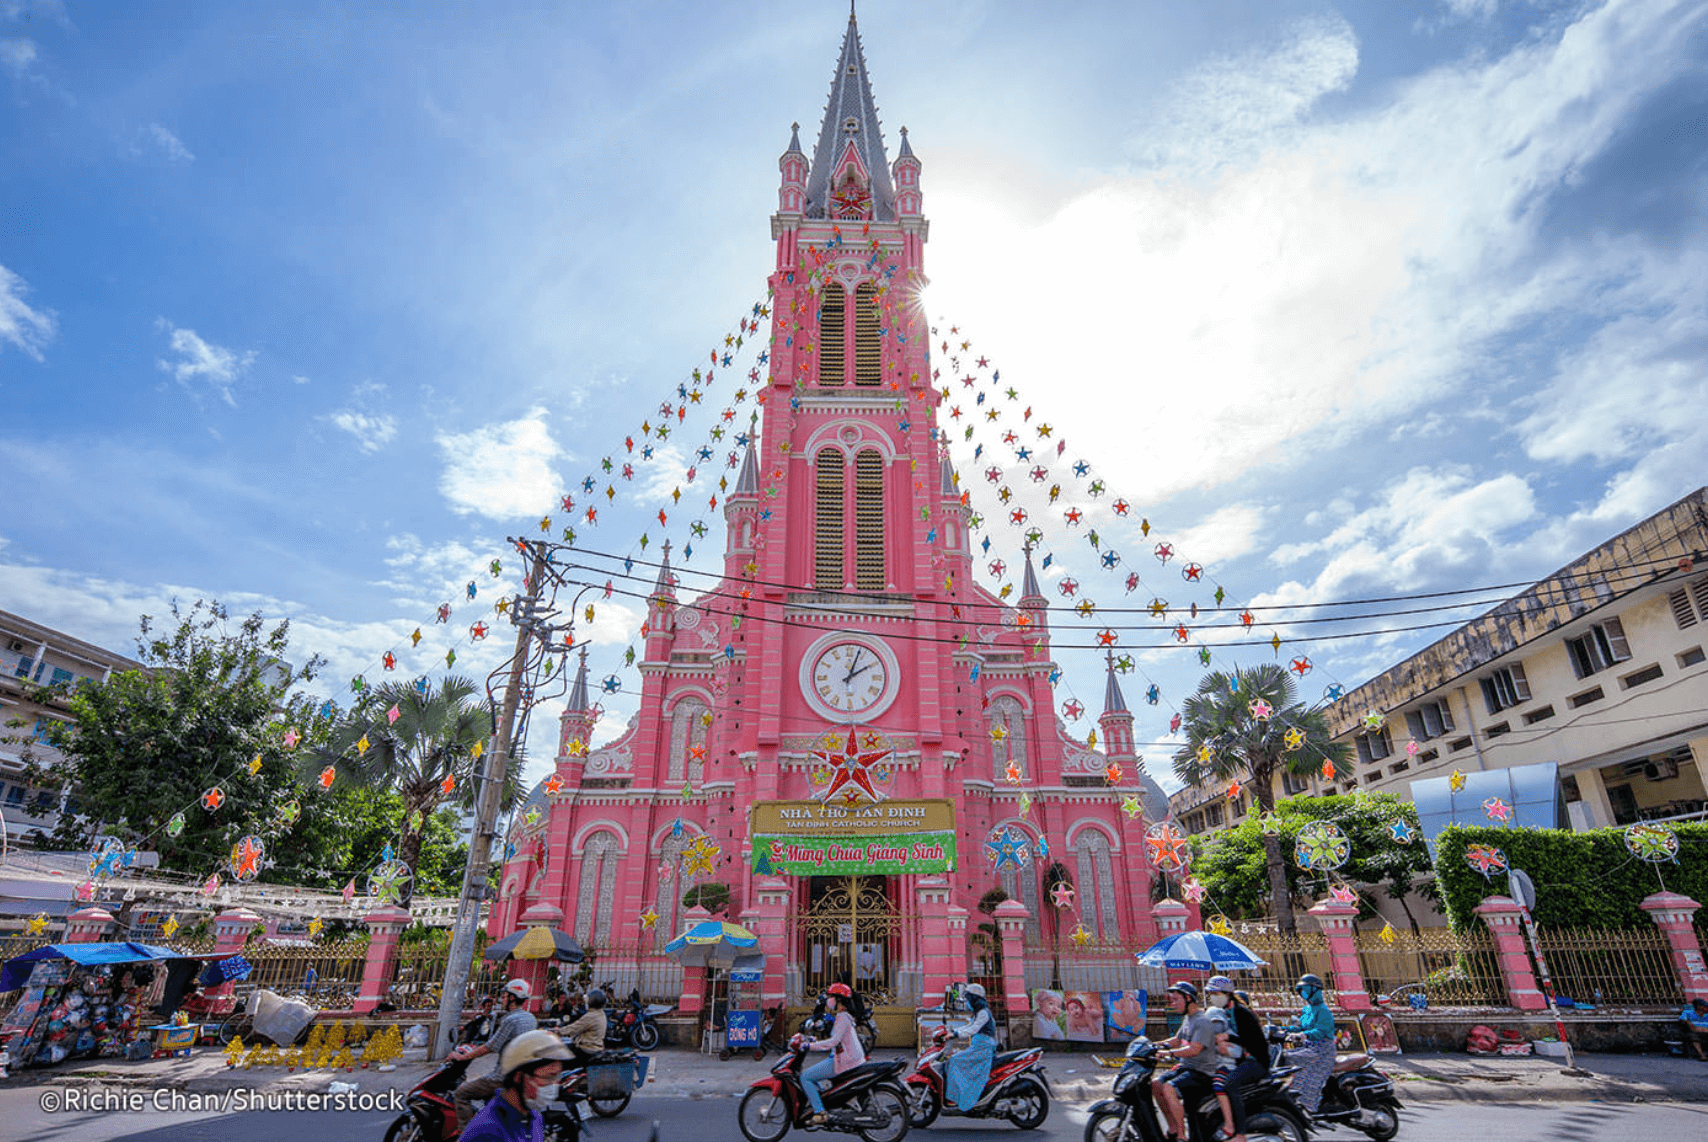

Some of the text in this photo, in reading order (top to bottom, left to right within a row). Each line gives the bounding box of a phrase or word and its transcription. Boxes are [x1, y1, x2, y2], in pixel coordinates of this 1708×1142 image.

[780, 806, 812, 818] NHÀ
[888, 807, 926, 819] ĐỊNH
[831, 820, 878, 828] CATHOLIC
[880, 819, 922, 828] CHURCH
[785, 842, 945, 866] Mừng Chúa Giáng Sinh
